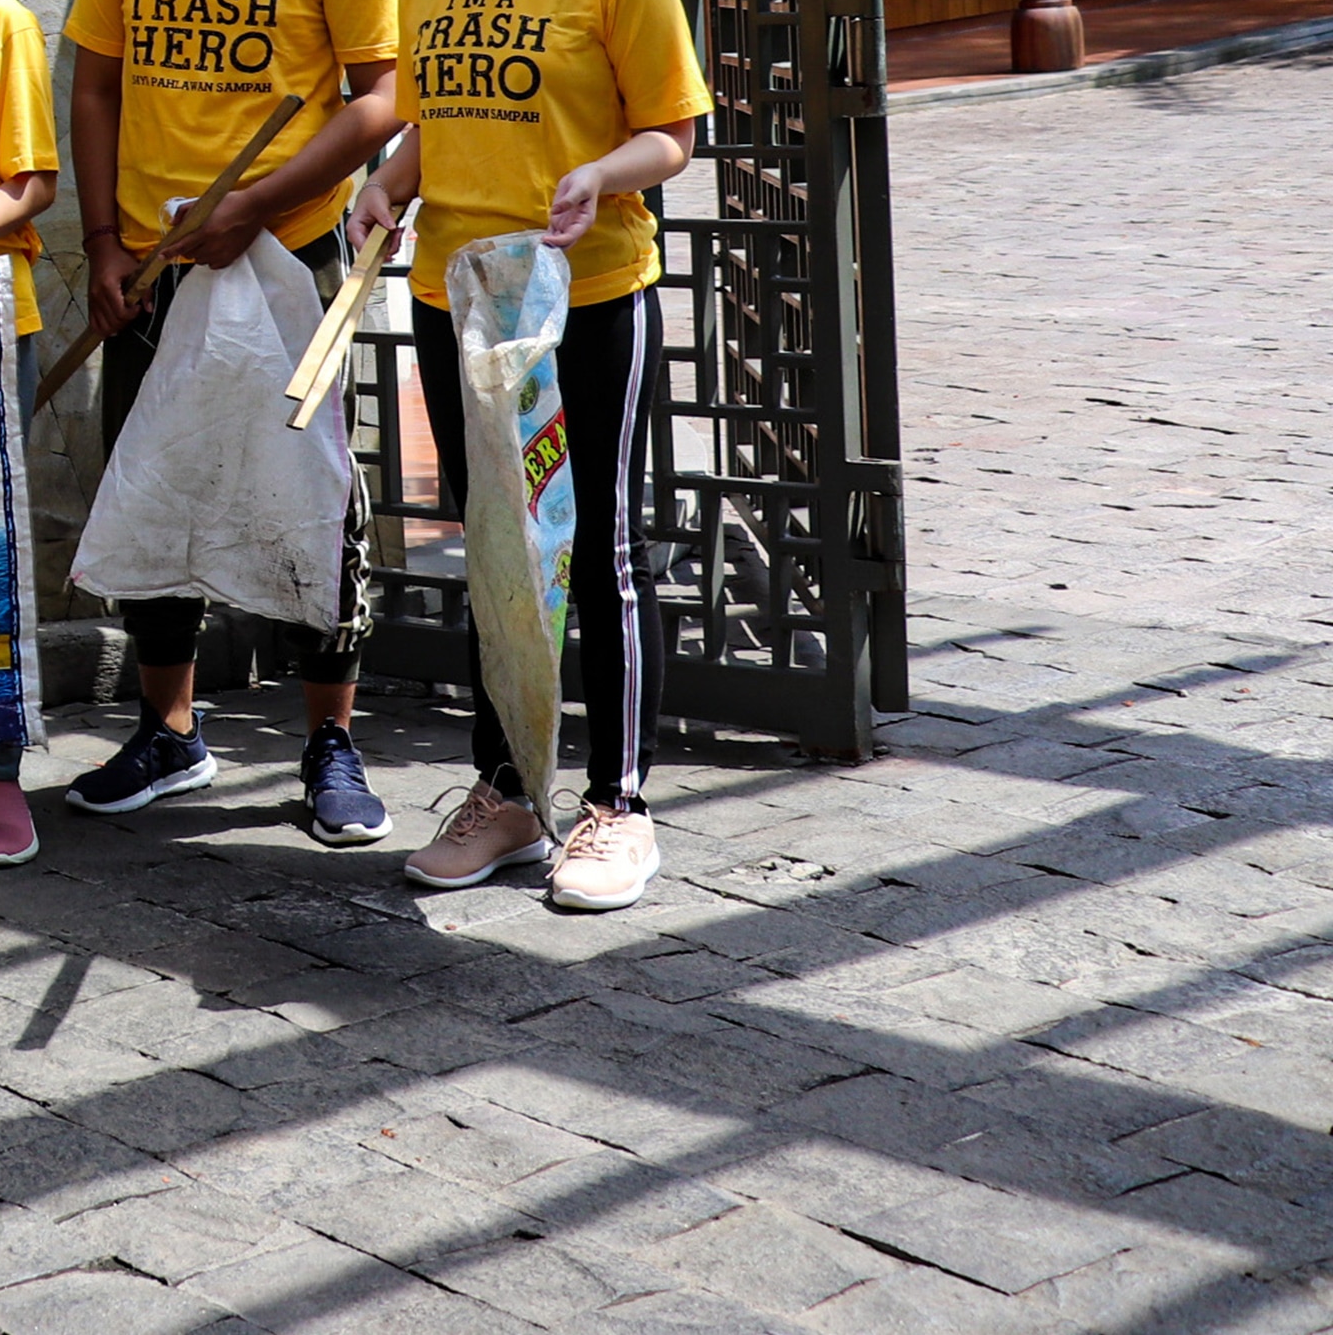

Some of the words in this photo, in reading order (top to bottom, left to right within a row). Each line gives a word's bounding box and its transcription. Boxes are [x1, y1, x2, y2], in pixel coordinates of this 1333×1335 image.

[131, 25, 273, 74] HERO
[413, 12, 552, 55] TRASH
[151, 76, 213, 92] PAHLAWAN
[216, 82, 272, 93] SAMPAH
[413, 53, 541, 101] HERO
[429, 107, 489, 120] PAHLAWAN
[490, 108, 540, 123] SAMPAH
